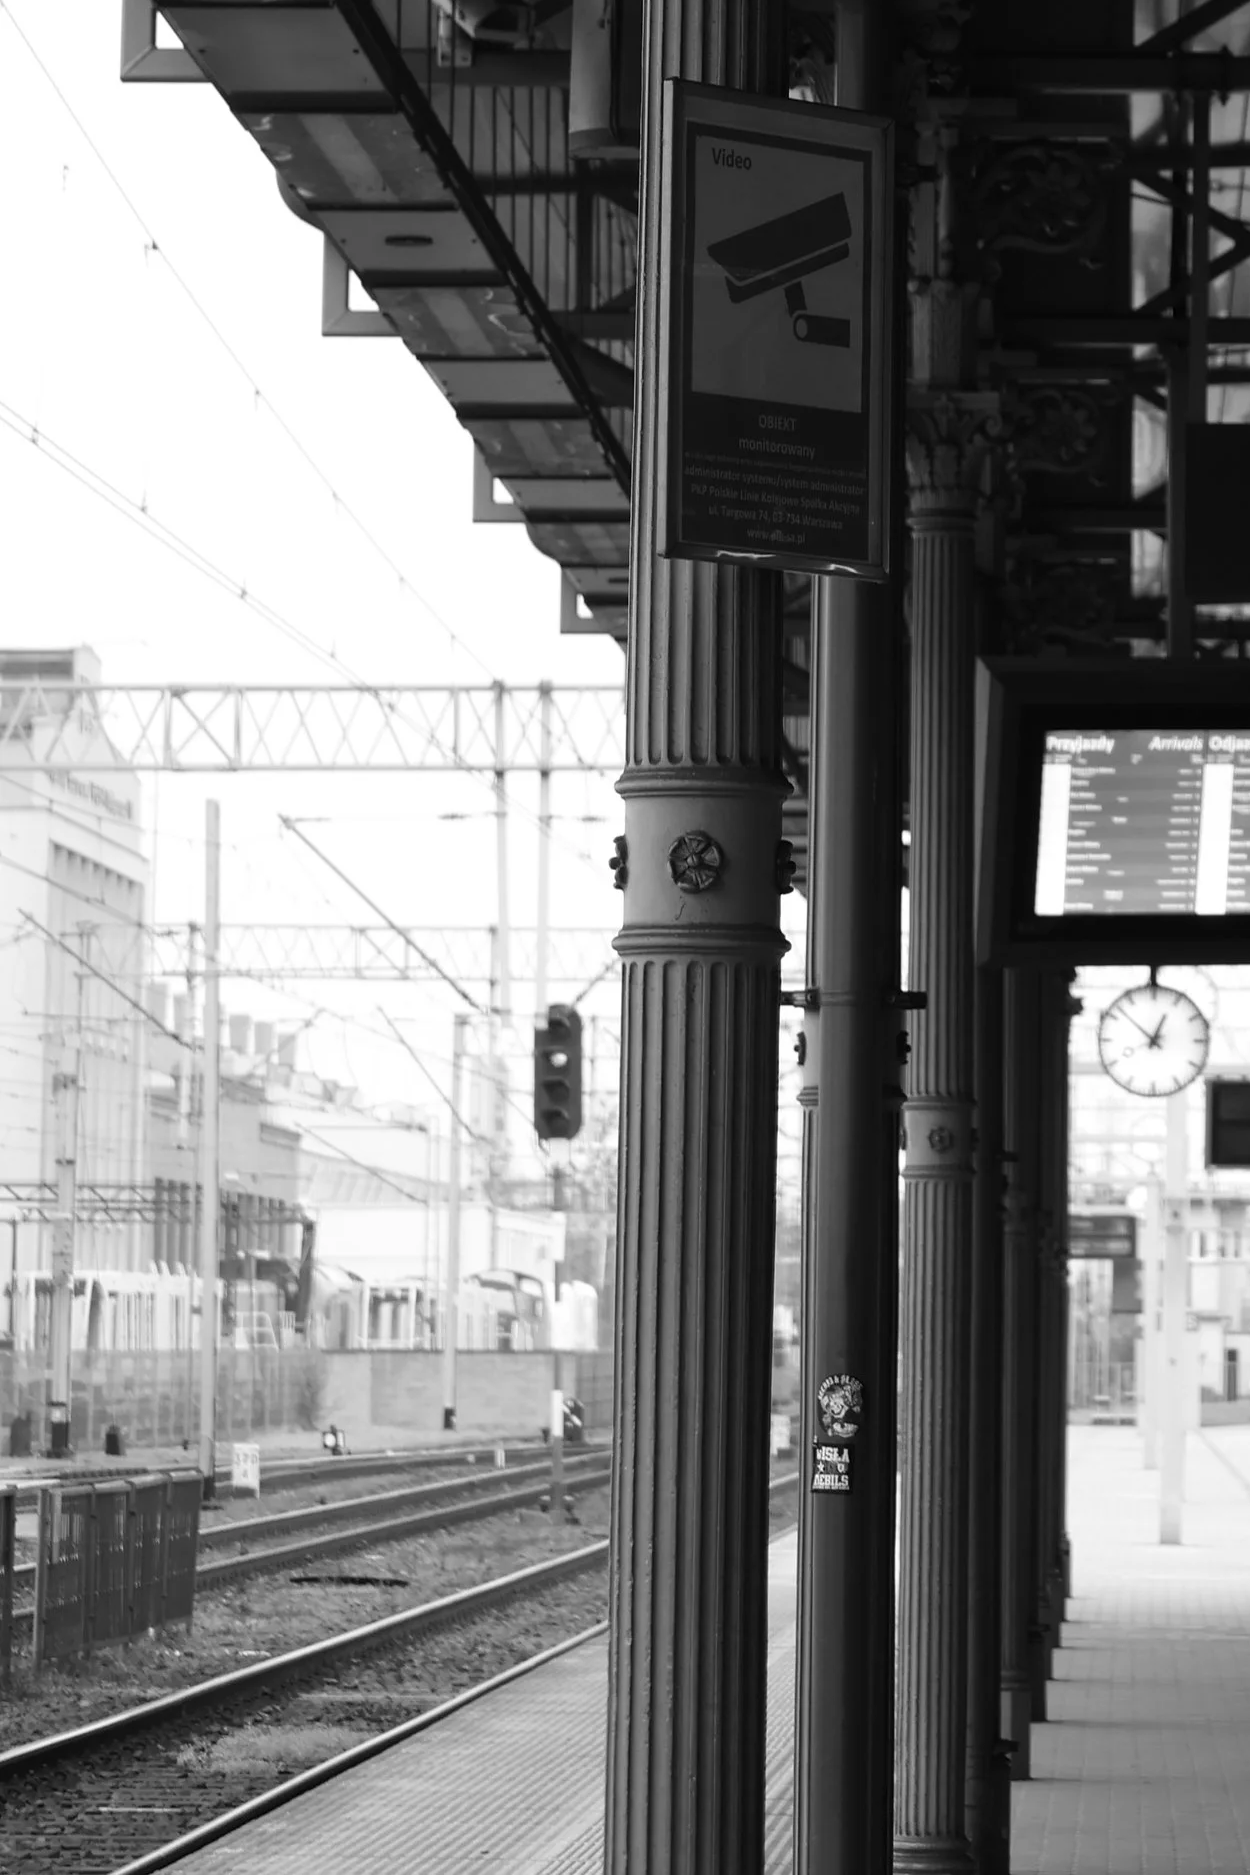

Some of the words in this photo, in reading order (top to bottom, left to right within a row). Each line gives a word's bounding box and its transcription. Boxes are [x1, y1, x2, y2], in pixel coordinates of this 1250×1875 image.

[711, 147, 752, 171] Video
[758, 414, 798, 432] OBIEKT
[738, 436, 816, 461] monitorowany
[1046, 735, 1115, 754] Przyjazdy
[1149, 736, 1204, 751] Arrivals
